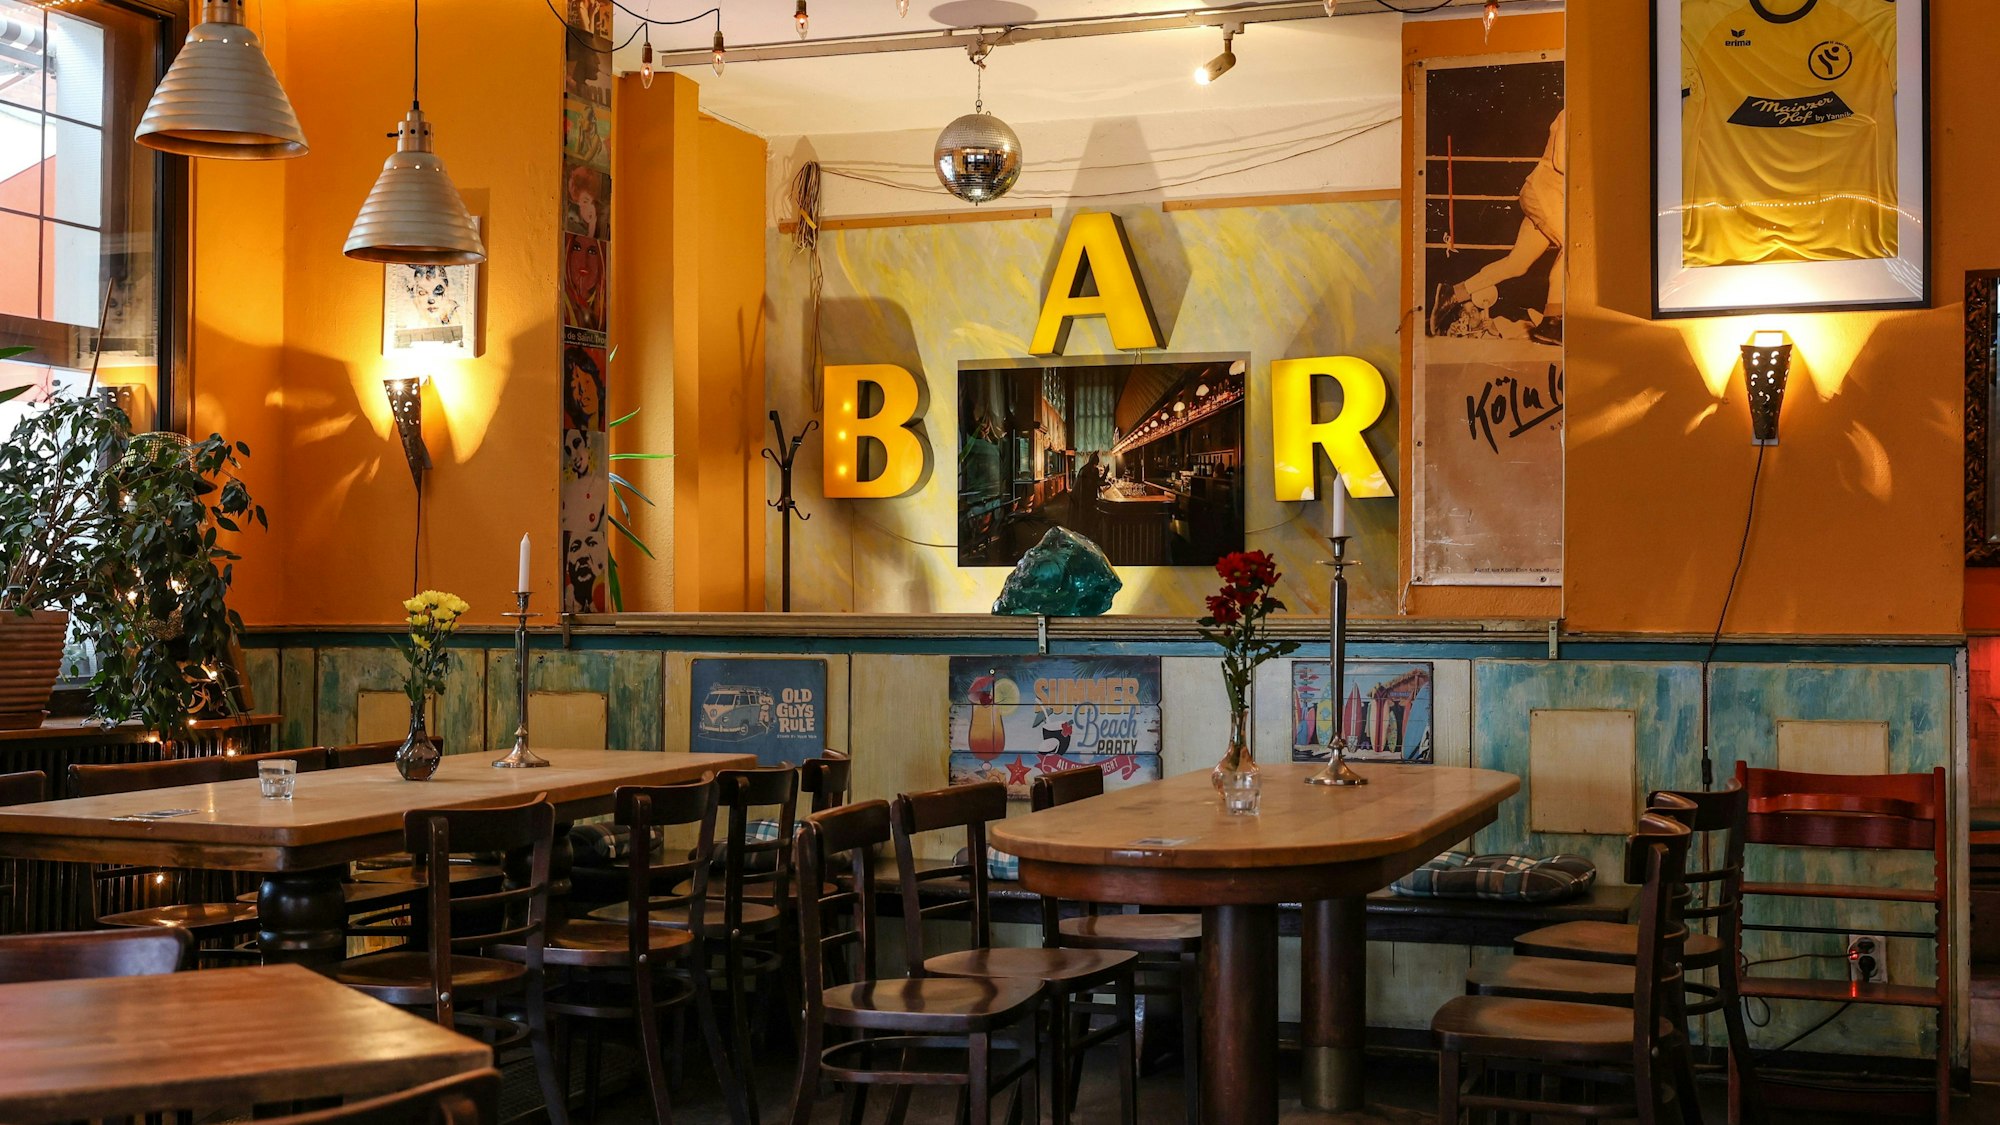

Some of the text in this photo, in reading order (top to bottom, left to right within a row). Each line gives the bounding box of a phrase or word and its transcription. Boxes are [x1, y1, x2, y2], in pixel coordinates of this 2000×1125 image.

[1752, 97, 1834, 112] Mainzer
[1775, 111, 1853, 125] Hof by Yannik
[1466, 376, 1544, 454] Köln
[781, 687, 812, 703] OLD
[1035, 678, 1140, 714] SUMMER
[776, 703, 814, 718] GUYS
[778, 717, 815, 733] RULE
[1074, 702, 1137, 748] Beach
[1097, 739, 1137, 755] PARTY
[1056, 758, 1068, 771] ALL
